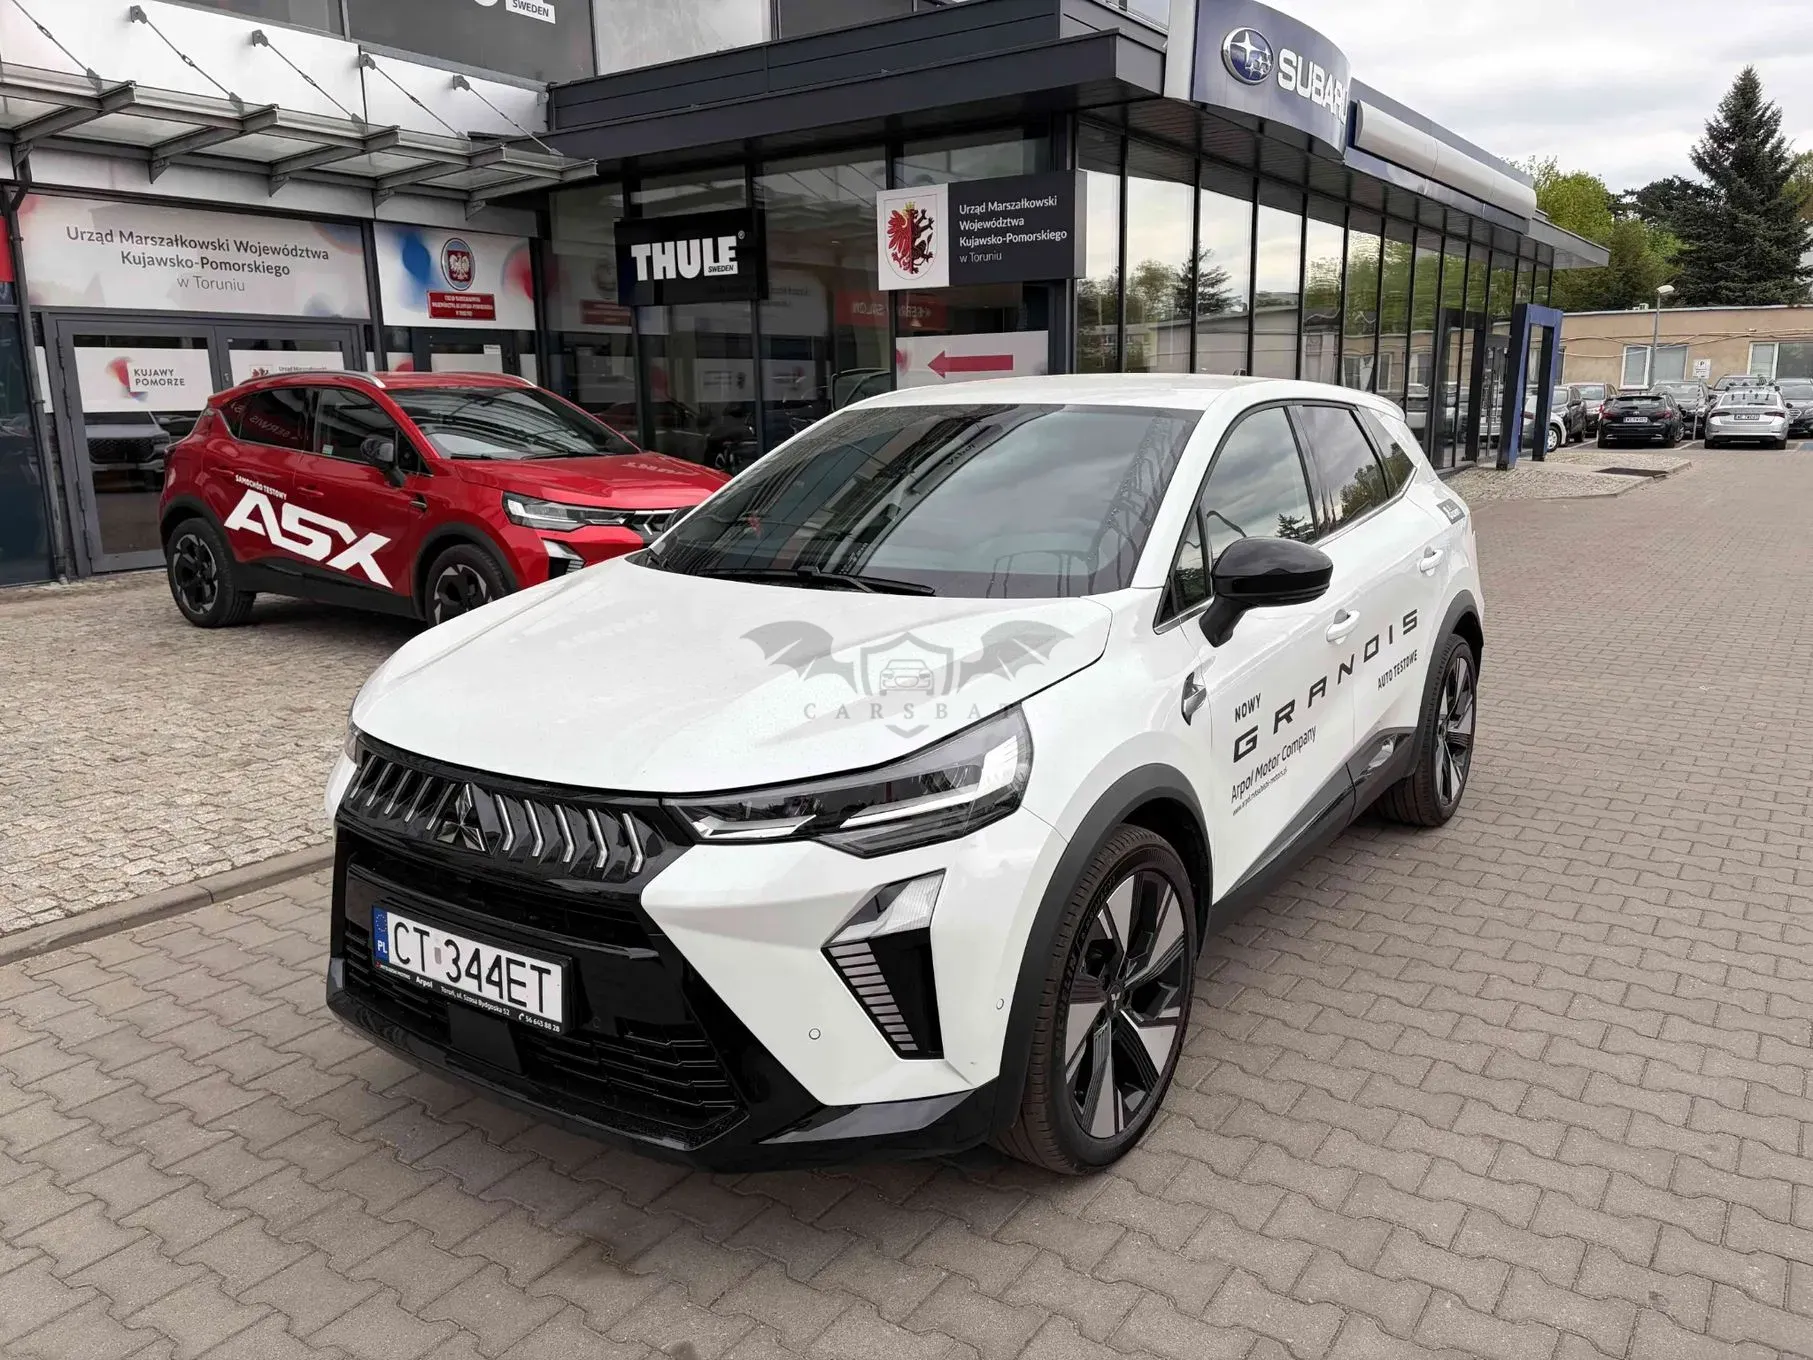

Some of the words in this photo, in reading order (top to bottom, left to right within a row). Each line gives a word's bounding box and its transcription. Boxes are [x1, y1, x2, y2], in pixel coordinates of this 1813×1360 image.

[512, 0, 549, 17] SWEDEN
[1277, 48, 1348, 125] SUBARU
[960, 202, 986, 215] Urząd
[988, 195, 1057, 212] Marszałkowski
[959, 217, 1025, 232] Województwa
[66, 226, 114, 245] Urząd
[119, 230, 230, 252] Marszałkowski
[233, 239, 329, 261] Województwa
[960, 229, 1067, 249] Kujawsko-Pomorskiego
[120, 250, 290, 278] Kujawsko-Pomorskiego
[631, 235, 739, 282] THULE
[959, 254, 968, 263] w
[969, 250, 1002, 263] Toruniu
[708, 264, 734, 273] SWEDEN
[177, 278, 189, 288] w
[192, 275, 246, 292] Toruniu
[133, 367, 175, 378] KUJAWY
[135, 377, 186, 387] POMORZE
[223, 488, 393, 589] ASX
[1377, 673, 1393, 692] AUTO
[1393, 649, 1418, 680] TESTOWE
[1233, 609, 1418, 764] GRANDIS
[1234, 692, 1262, 723] NOWY
[1231, 769, 1254, 804] Arpol
[1255, 751, 1280, 784] Motor
[1281, 725, 1317, 761] Company
[377, 940, 387, 953] PL
[394, 922, 430, 972] CT
[444, 939, 551, 1014] 344ET
[415, 976, 433, 988] Arpol
